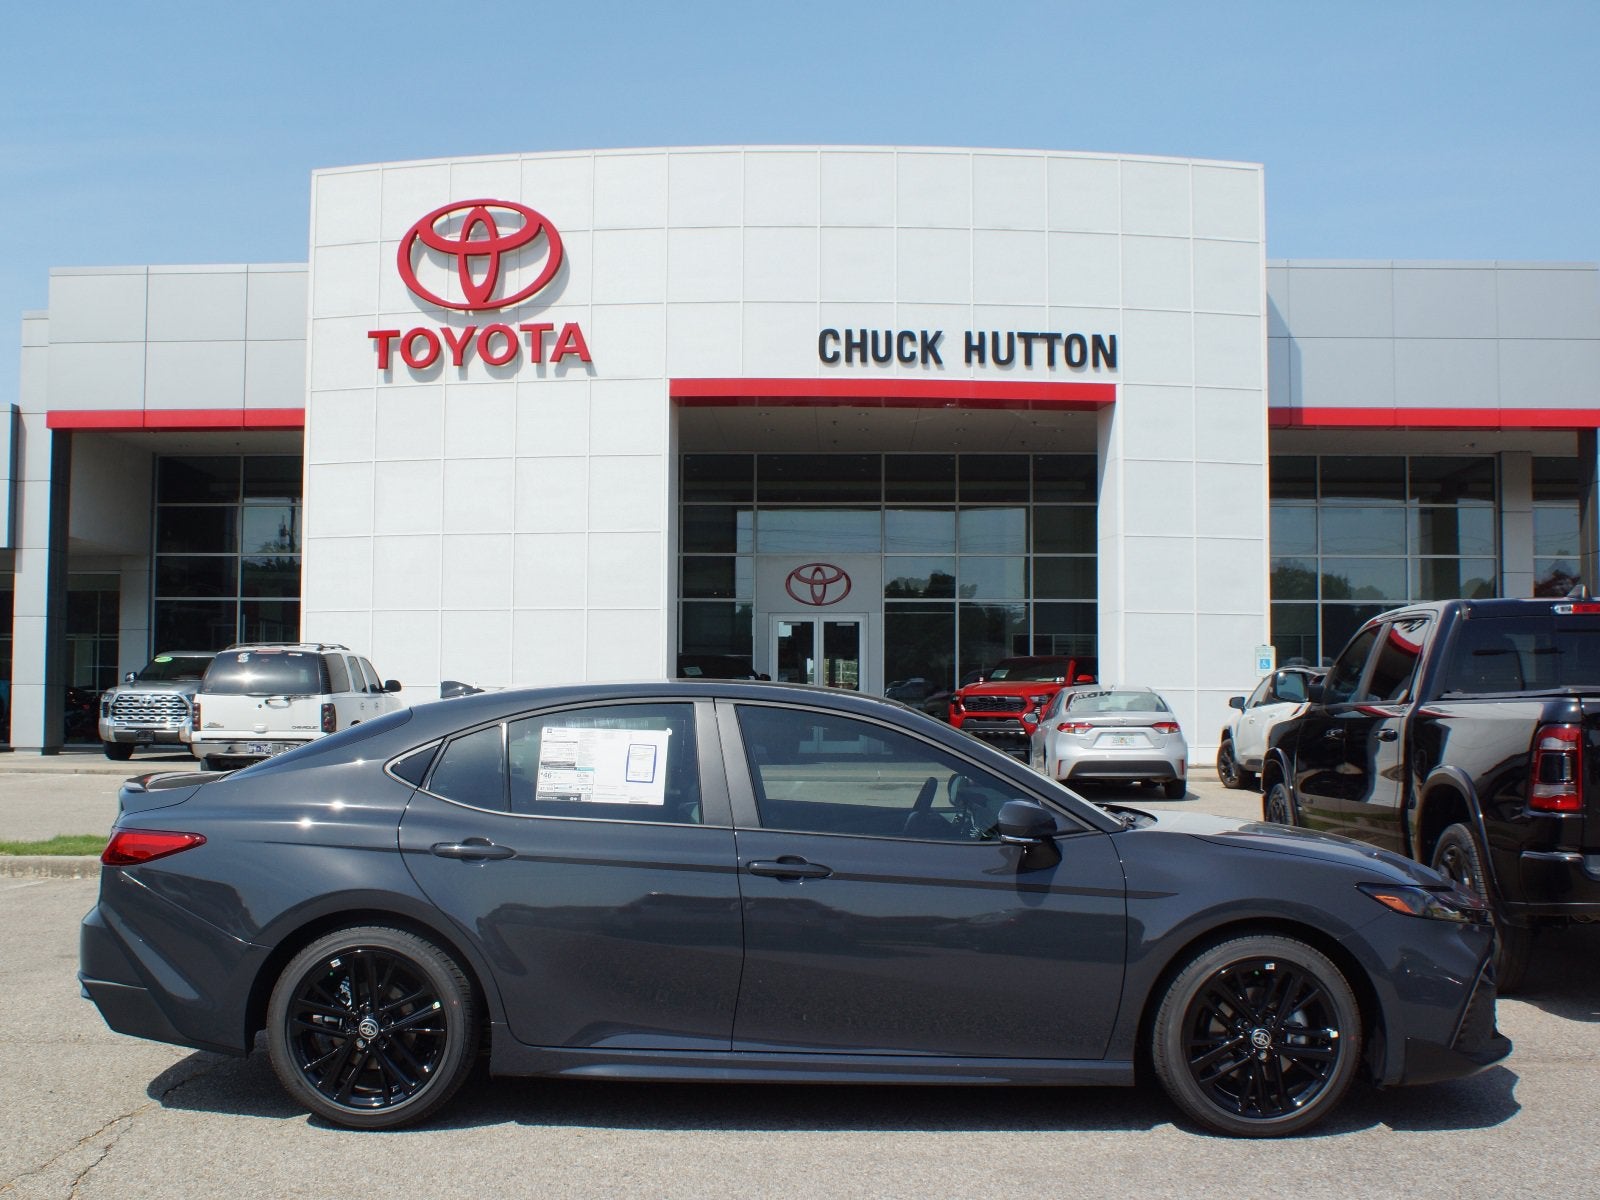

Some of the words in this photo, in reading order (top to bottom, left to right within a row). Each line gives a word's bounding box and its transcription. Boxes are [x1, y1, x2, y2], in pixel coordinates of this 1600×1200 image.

[368, 322, 592, 369] TOYOTA
[818, 328, 943, 365] CHUCK
[964, 331, 1117, 368] HUTTON
